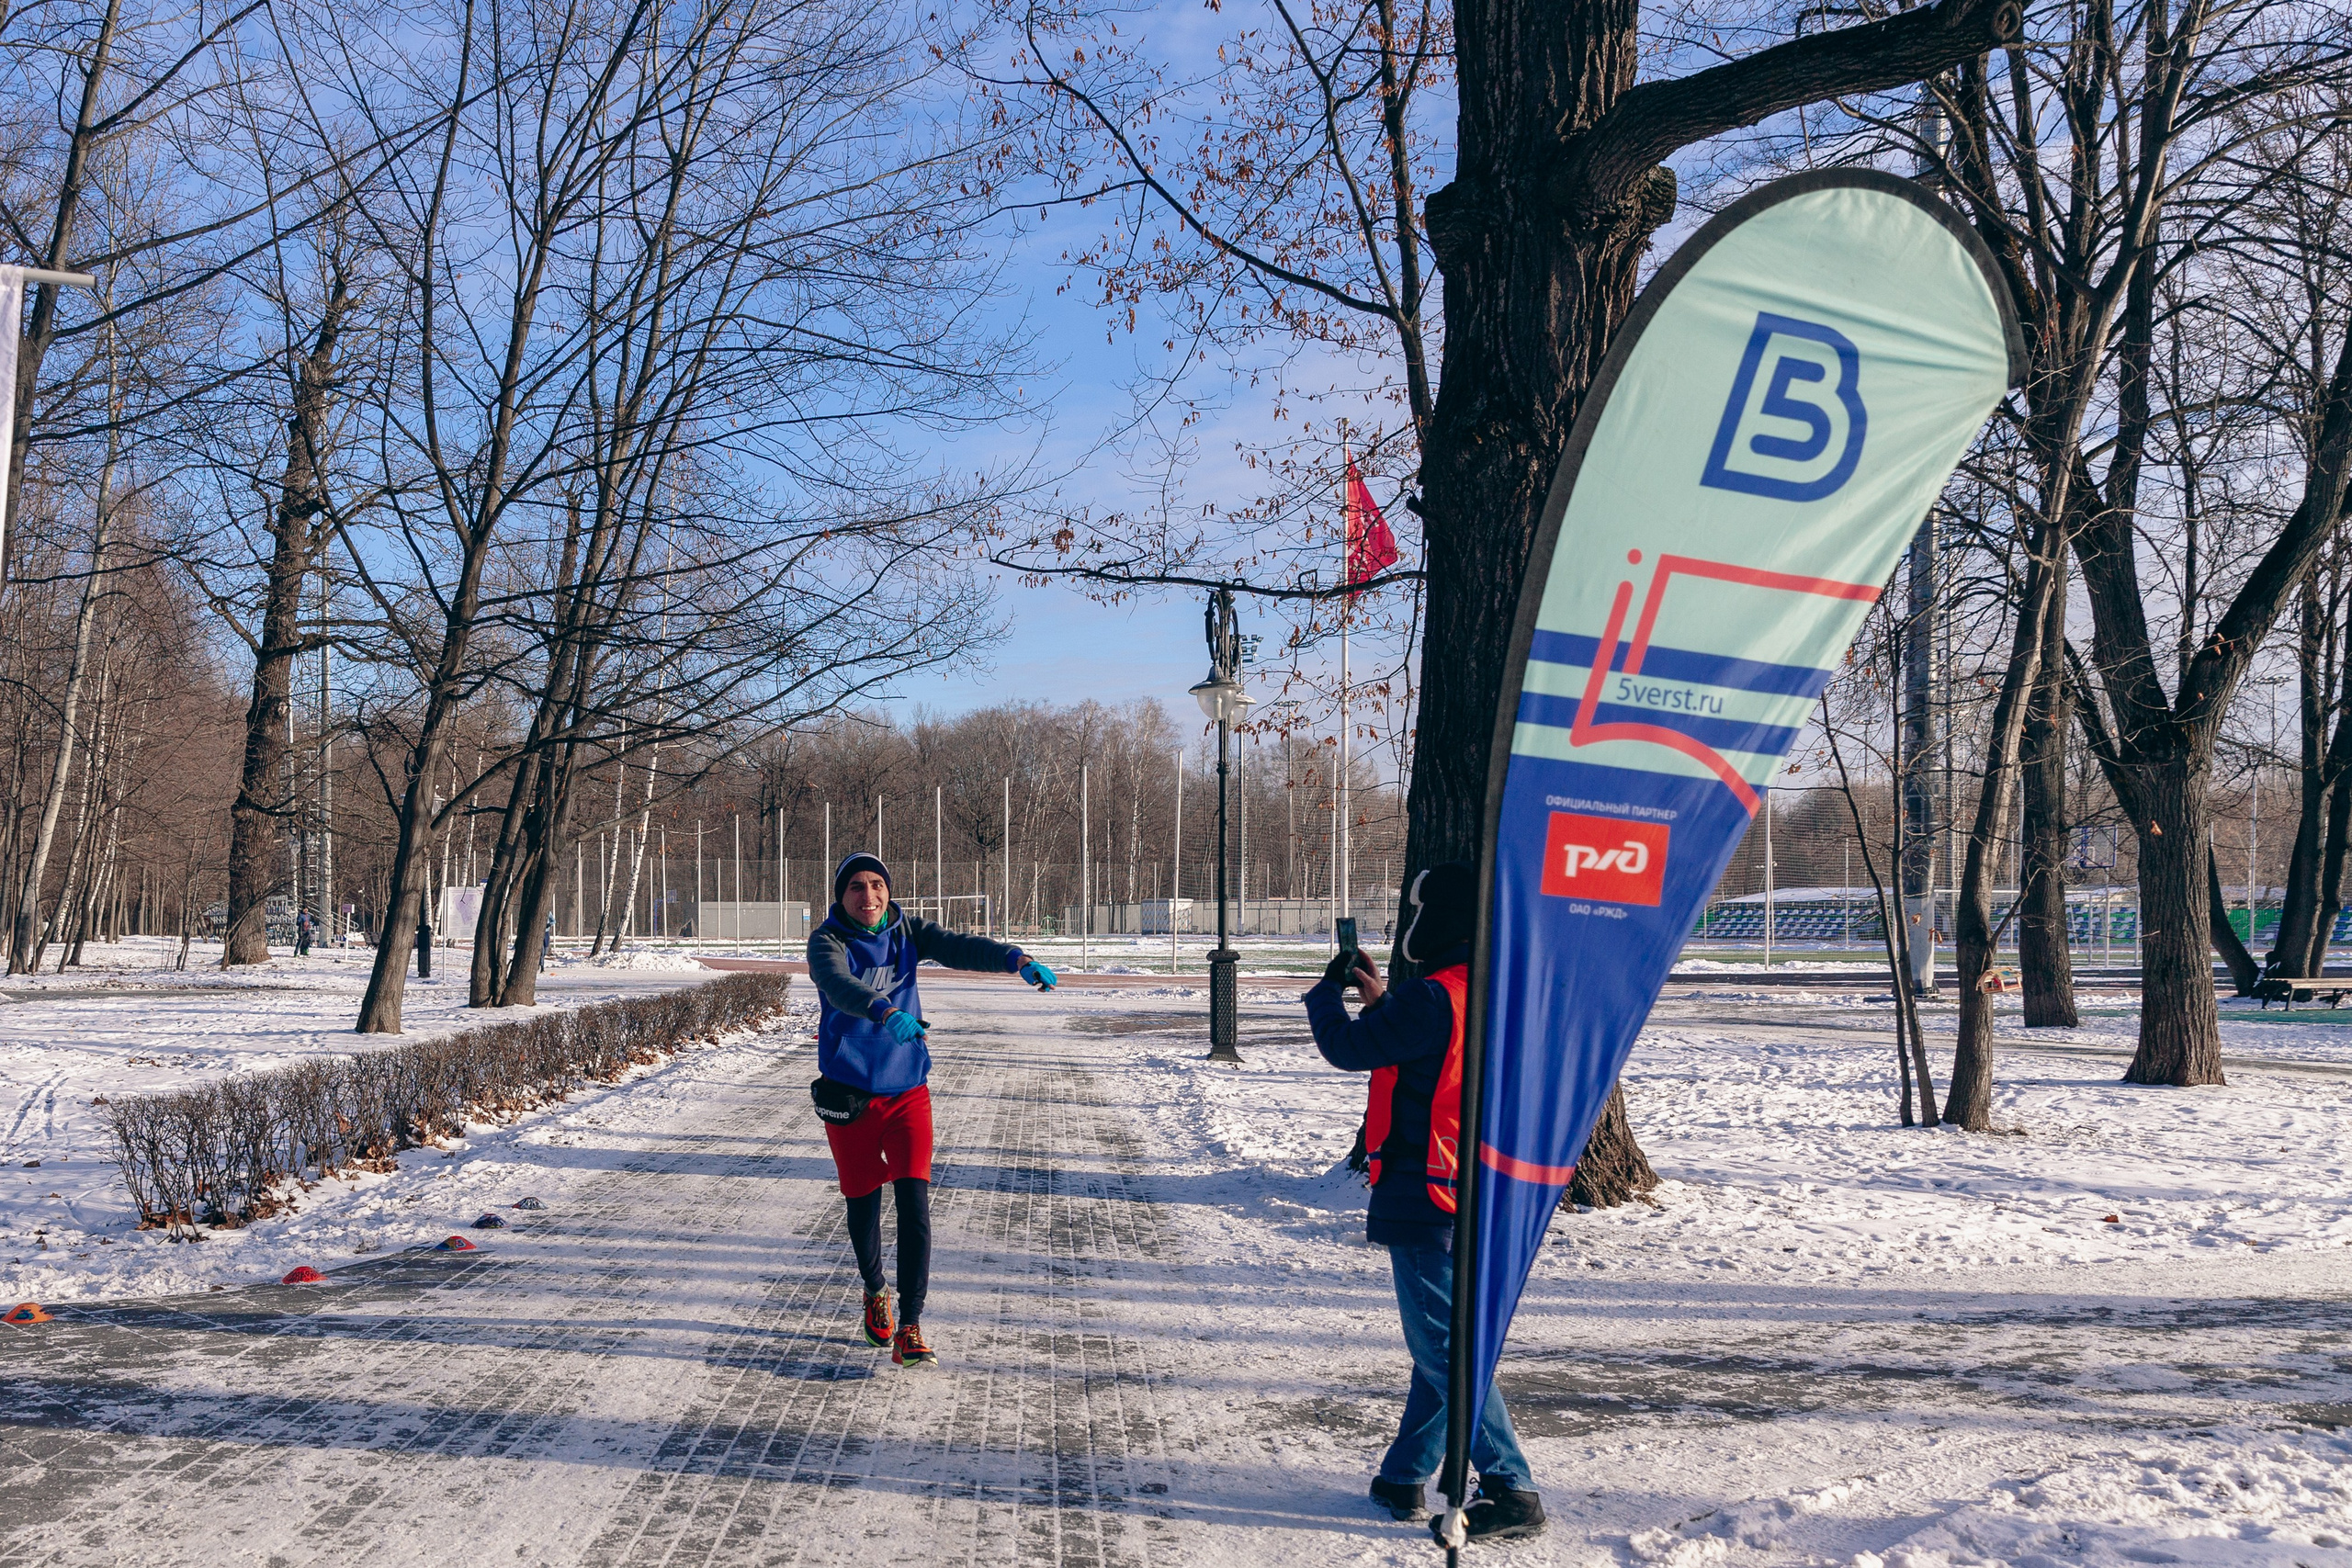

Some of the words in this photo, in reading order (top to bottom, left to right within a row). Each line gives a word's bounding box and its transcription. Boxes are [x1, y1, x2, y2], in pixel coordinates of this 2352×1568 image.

[1616, 678, 1723, 714] 5verst.ru
[1545, 795, 1630, 815] ОФИЦИАЛЬНЫЙ
[1632, 805, 1678, 820] ПАРТНЕР
[1569, 903, 1591, 916] ОАО
[861, 964, 897, 990] NIKE
